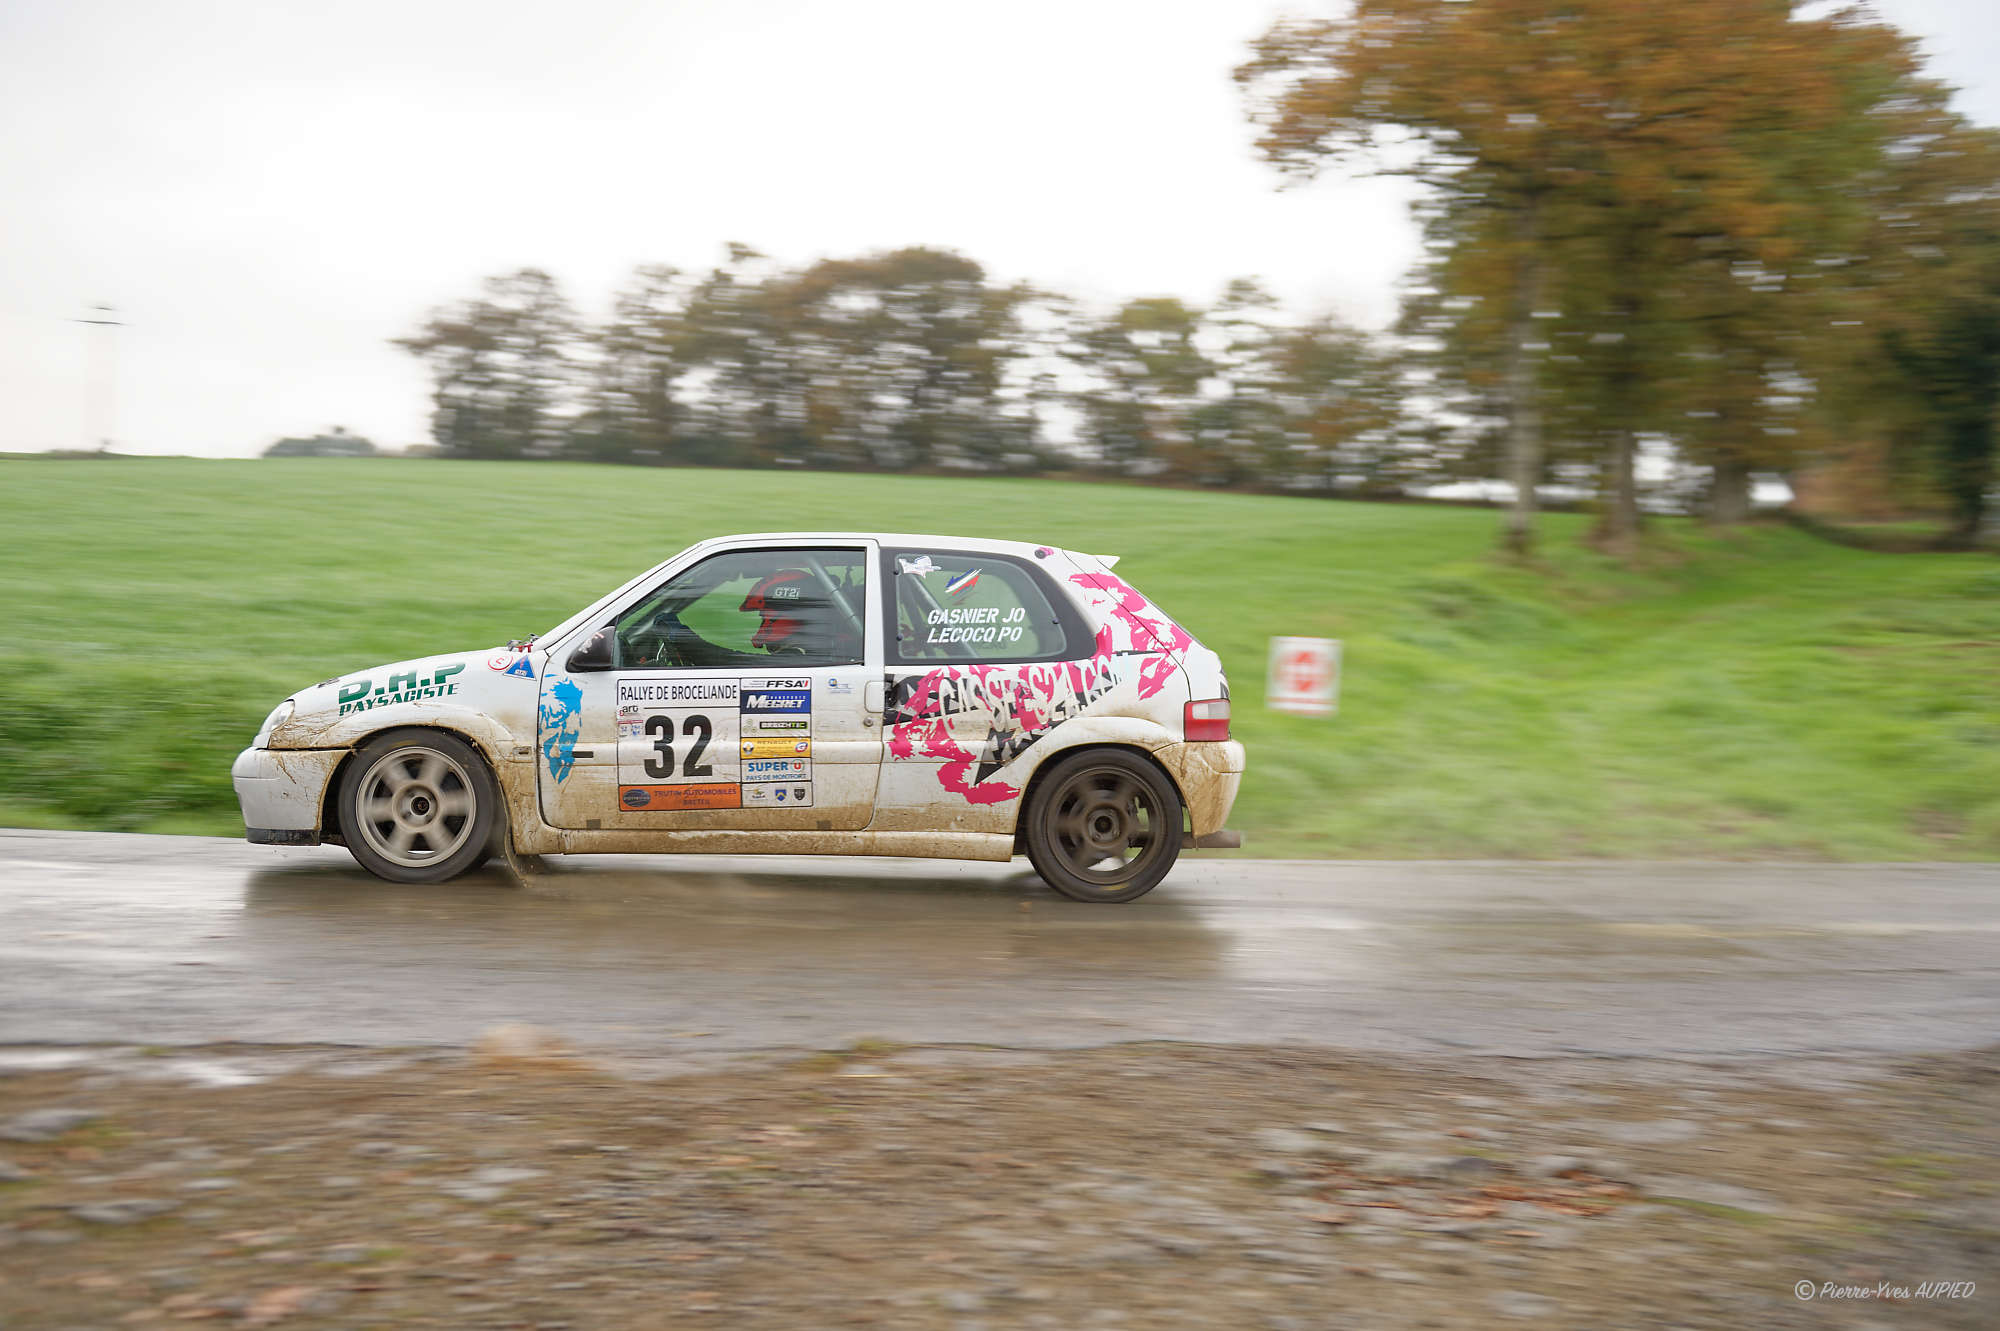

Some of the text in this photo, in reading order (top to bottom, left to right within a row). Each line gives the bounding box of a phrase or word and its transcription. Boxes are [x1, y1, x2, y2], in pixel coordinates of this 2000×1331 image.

[927, 607, 1026, 624] GASNIER JO
[926, 626, 1023, 643] LECOCQ PO
[620, 685, 737, 700] RALLYE DE BROCELIANDE
[766, 680, 803, 688] FFSA
[338, 682, 461, 717] PAYSAGISTE
[643, 714, 713, 779] 32
[748, 762, 802, 772] SUPER U
